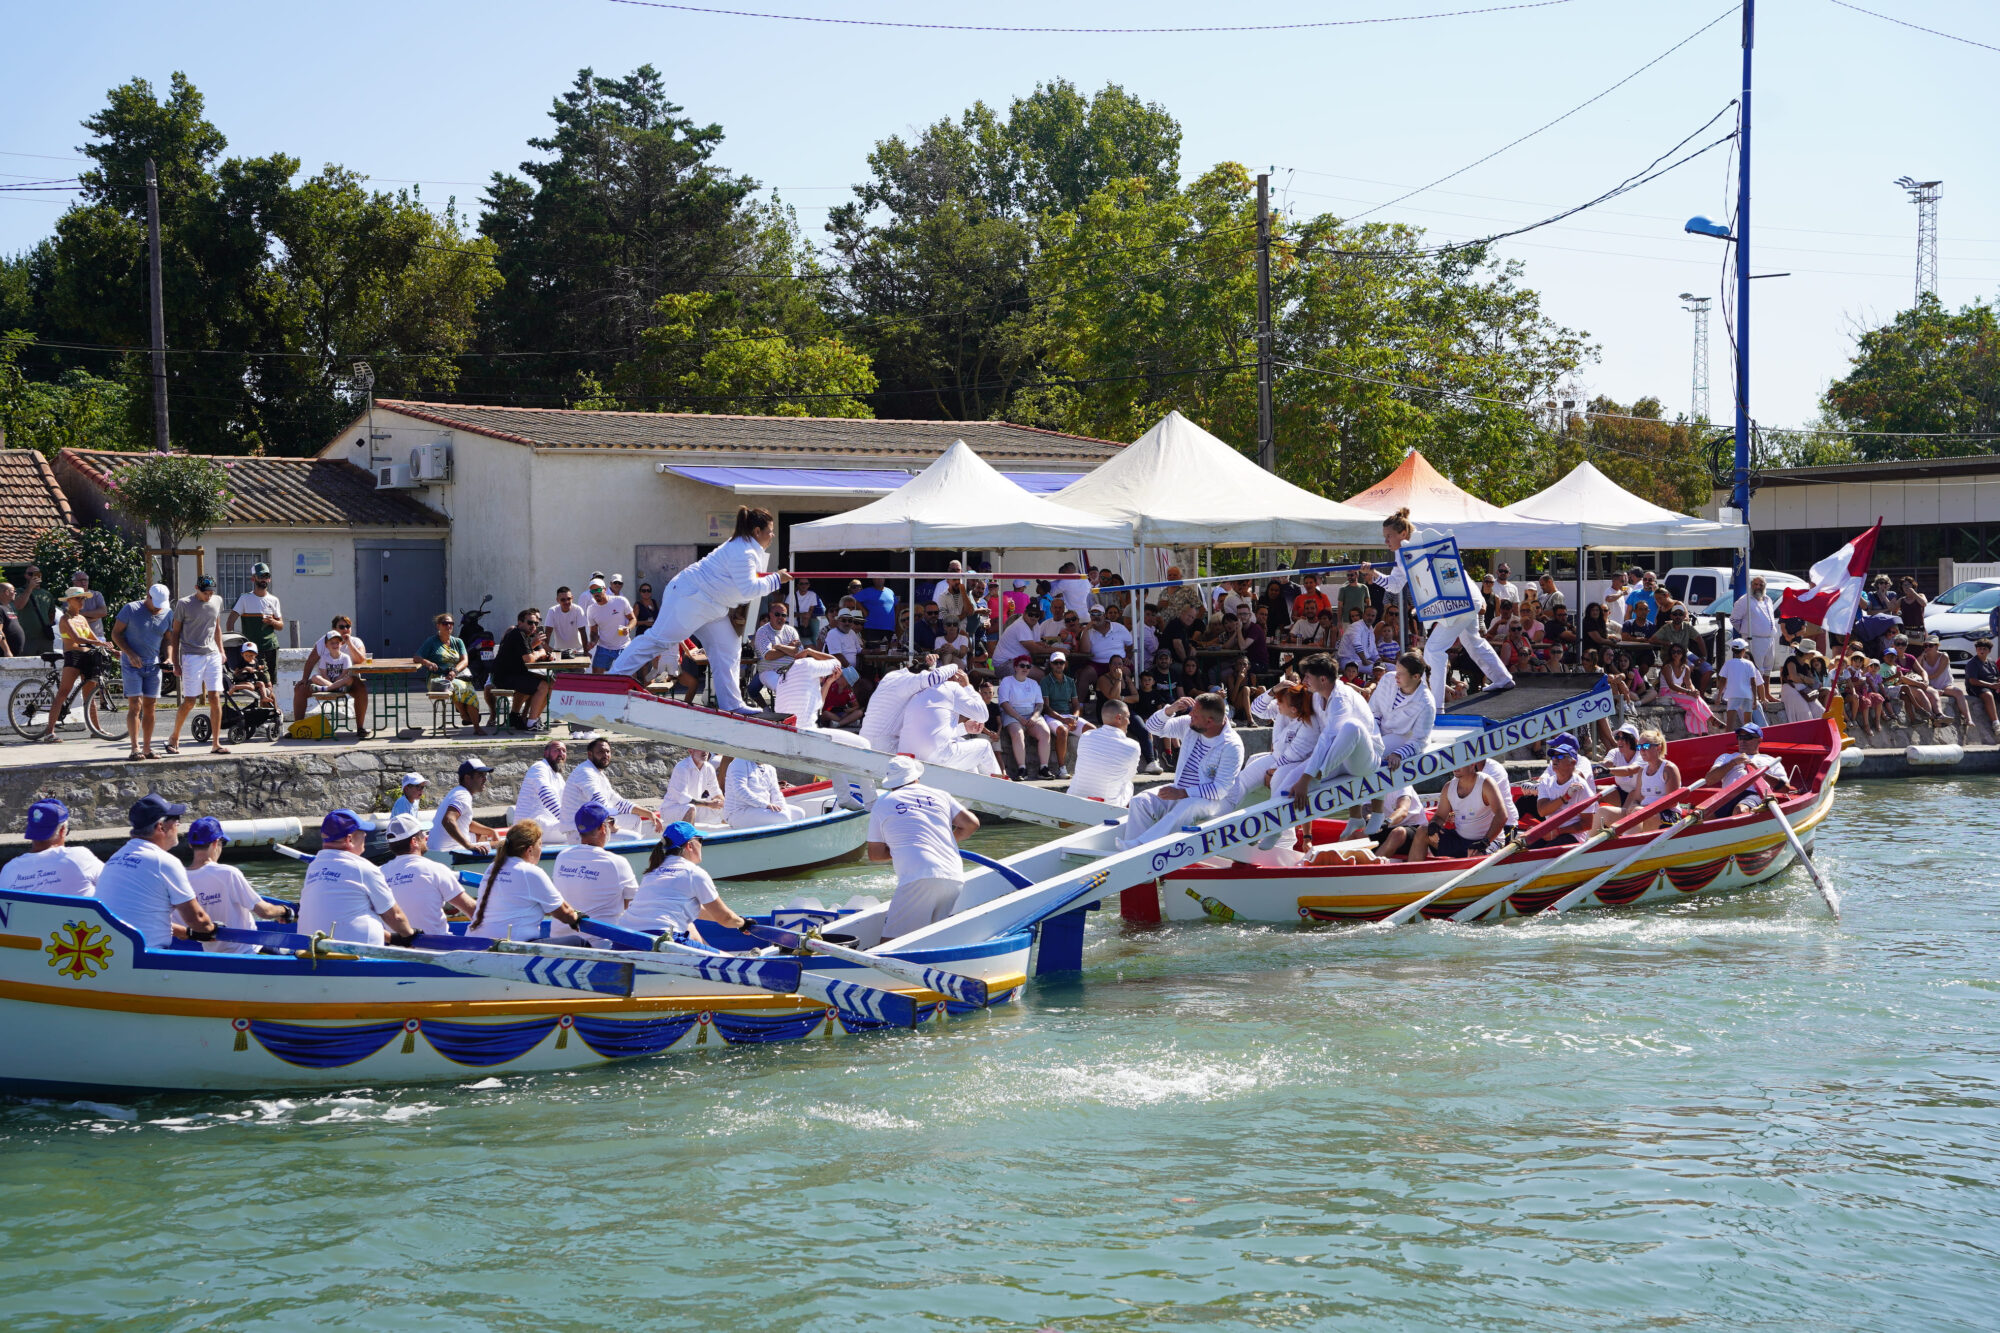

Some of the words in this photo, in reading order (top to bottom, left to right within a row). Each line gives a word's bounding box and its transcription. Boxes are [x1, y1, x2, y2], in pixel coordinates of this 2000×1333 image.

[1423, 599, 1470, 616] FRONTIGNAN
[560, 695, 575, 706] SJF
[1200, 766, 1395, 855] FRONTIGNAN
[1401, 744, 1456, 783] SON
[1464, 706, 1571, 762] MUSCAT
